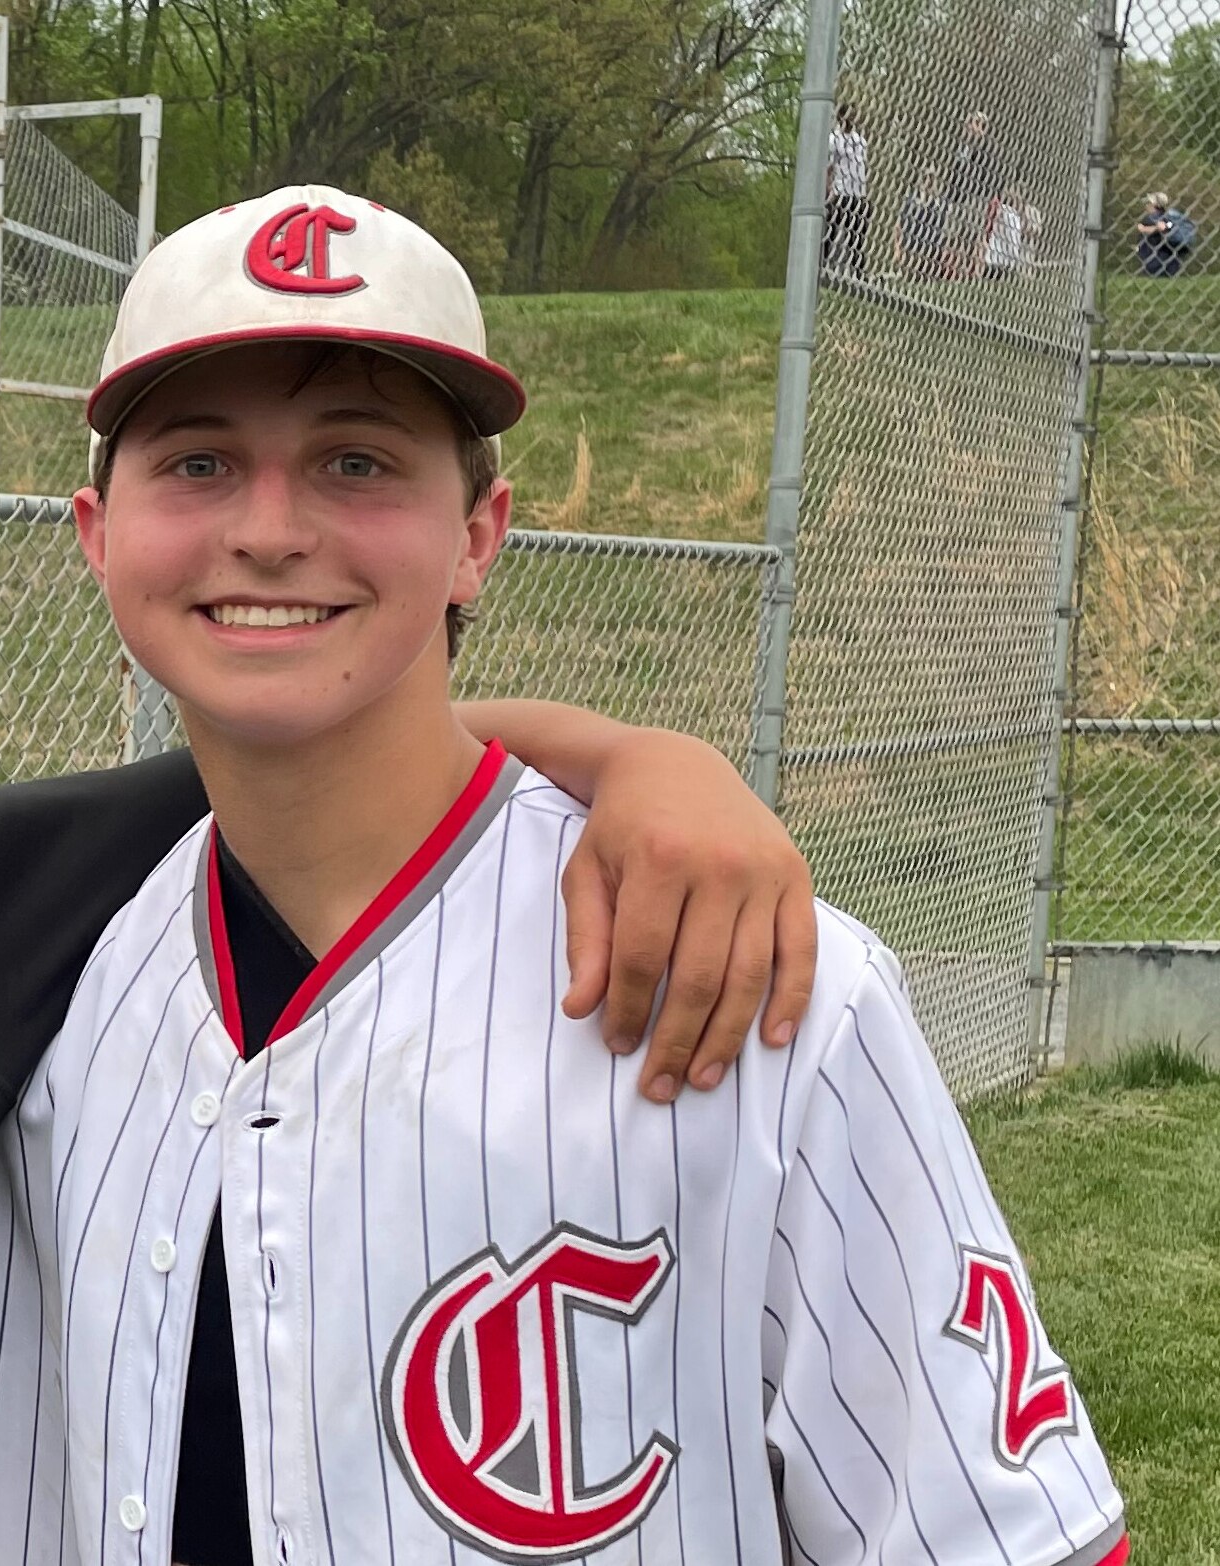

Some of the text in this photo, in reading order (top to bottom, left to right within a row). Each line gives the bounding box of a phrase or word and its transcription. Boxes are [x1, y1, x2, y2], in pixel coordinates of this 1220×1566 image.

[244, 203, 368, 297] C
[380, 1220, 681, 1565] C
[942, 1243, 1078, 1472] 2
